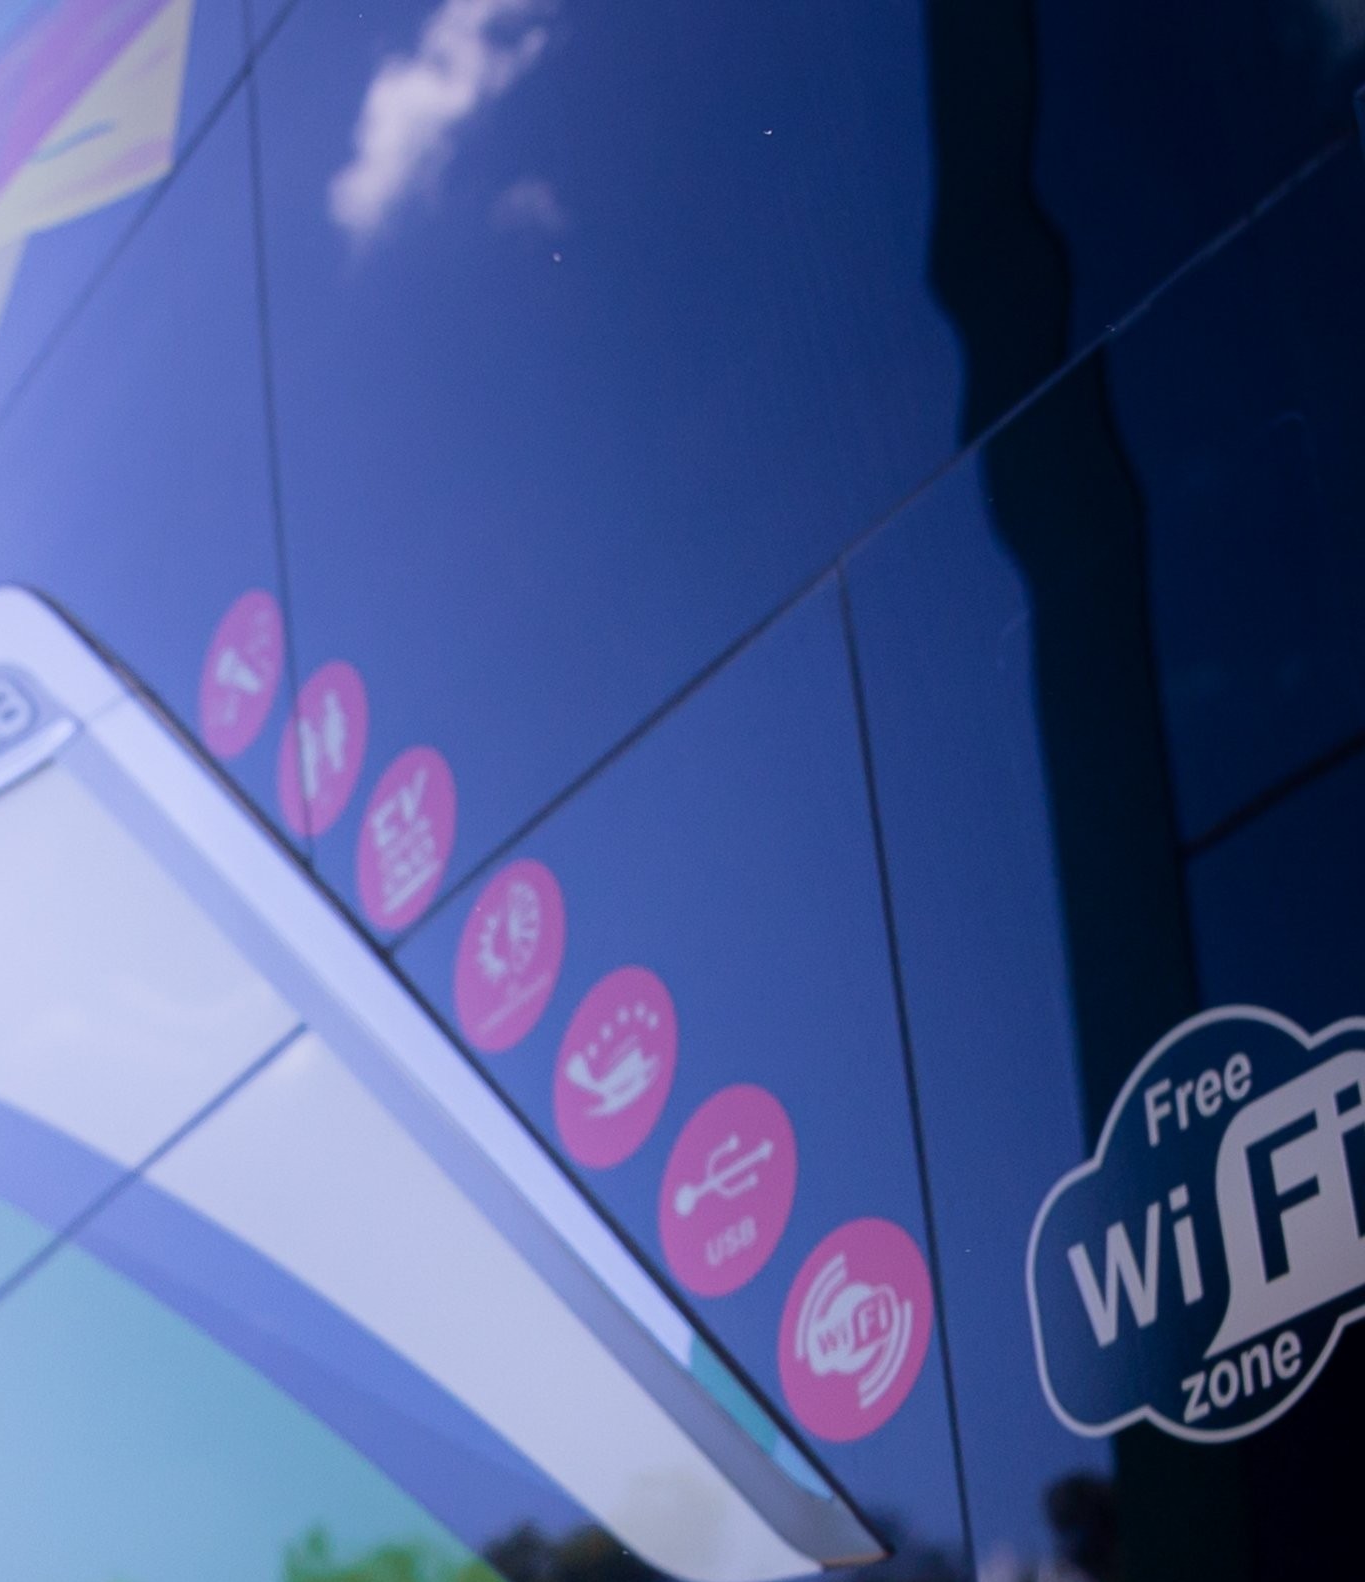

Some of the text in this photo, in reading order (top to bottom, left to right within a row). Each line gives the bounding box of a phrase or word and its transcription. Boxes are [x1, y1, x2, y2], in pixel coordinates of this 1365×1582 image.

[1145, 1052, 1253, 1147] Free
[705, 1216, 757, 1265] USB
[1182, 1330, 1303, 1424] zone
